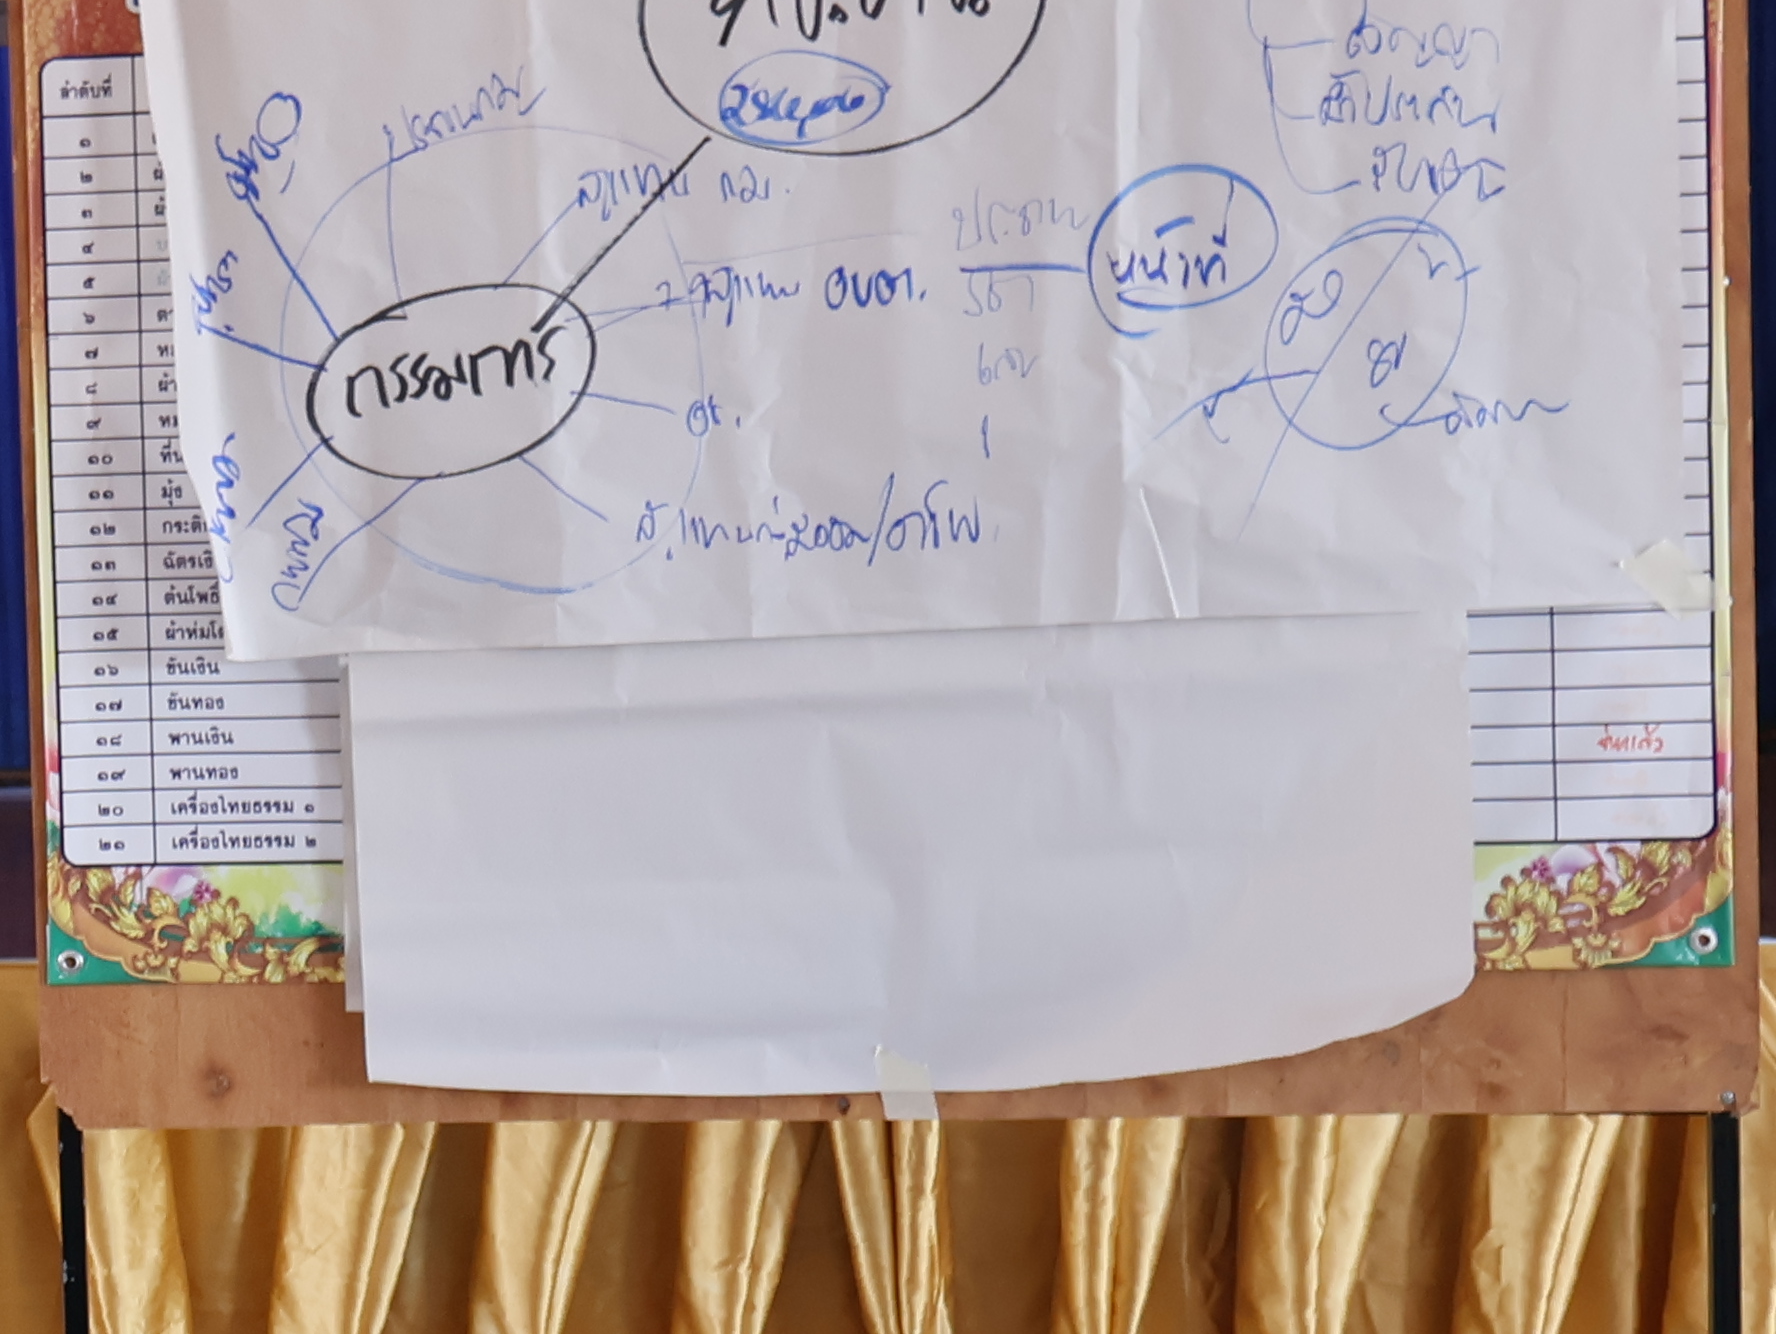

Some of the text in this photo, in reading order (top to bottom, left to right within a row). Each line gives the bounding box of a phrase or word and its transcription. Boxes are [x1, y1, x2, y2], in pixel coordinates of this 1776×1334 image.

[60, 74, 113, 100] ลำดับที่
[163, 551, 213, 570] ฉัตรเงิ
[169, 727, 234, 746] พานเงิน
[169, 765, 239, 781] พานทอง
[170, 791, 294, 816] เครื่องไทยธรรม
[171, 829, 296, 851] เครื่องไทยธรรม
